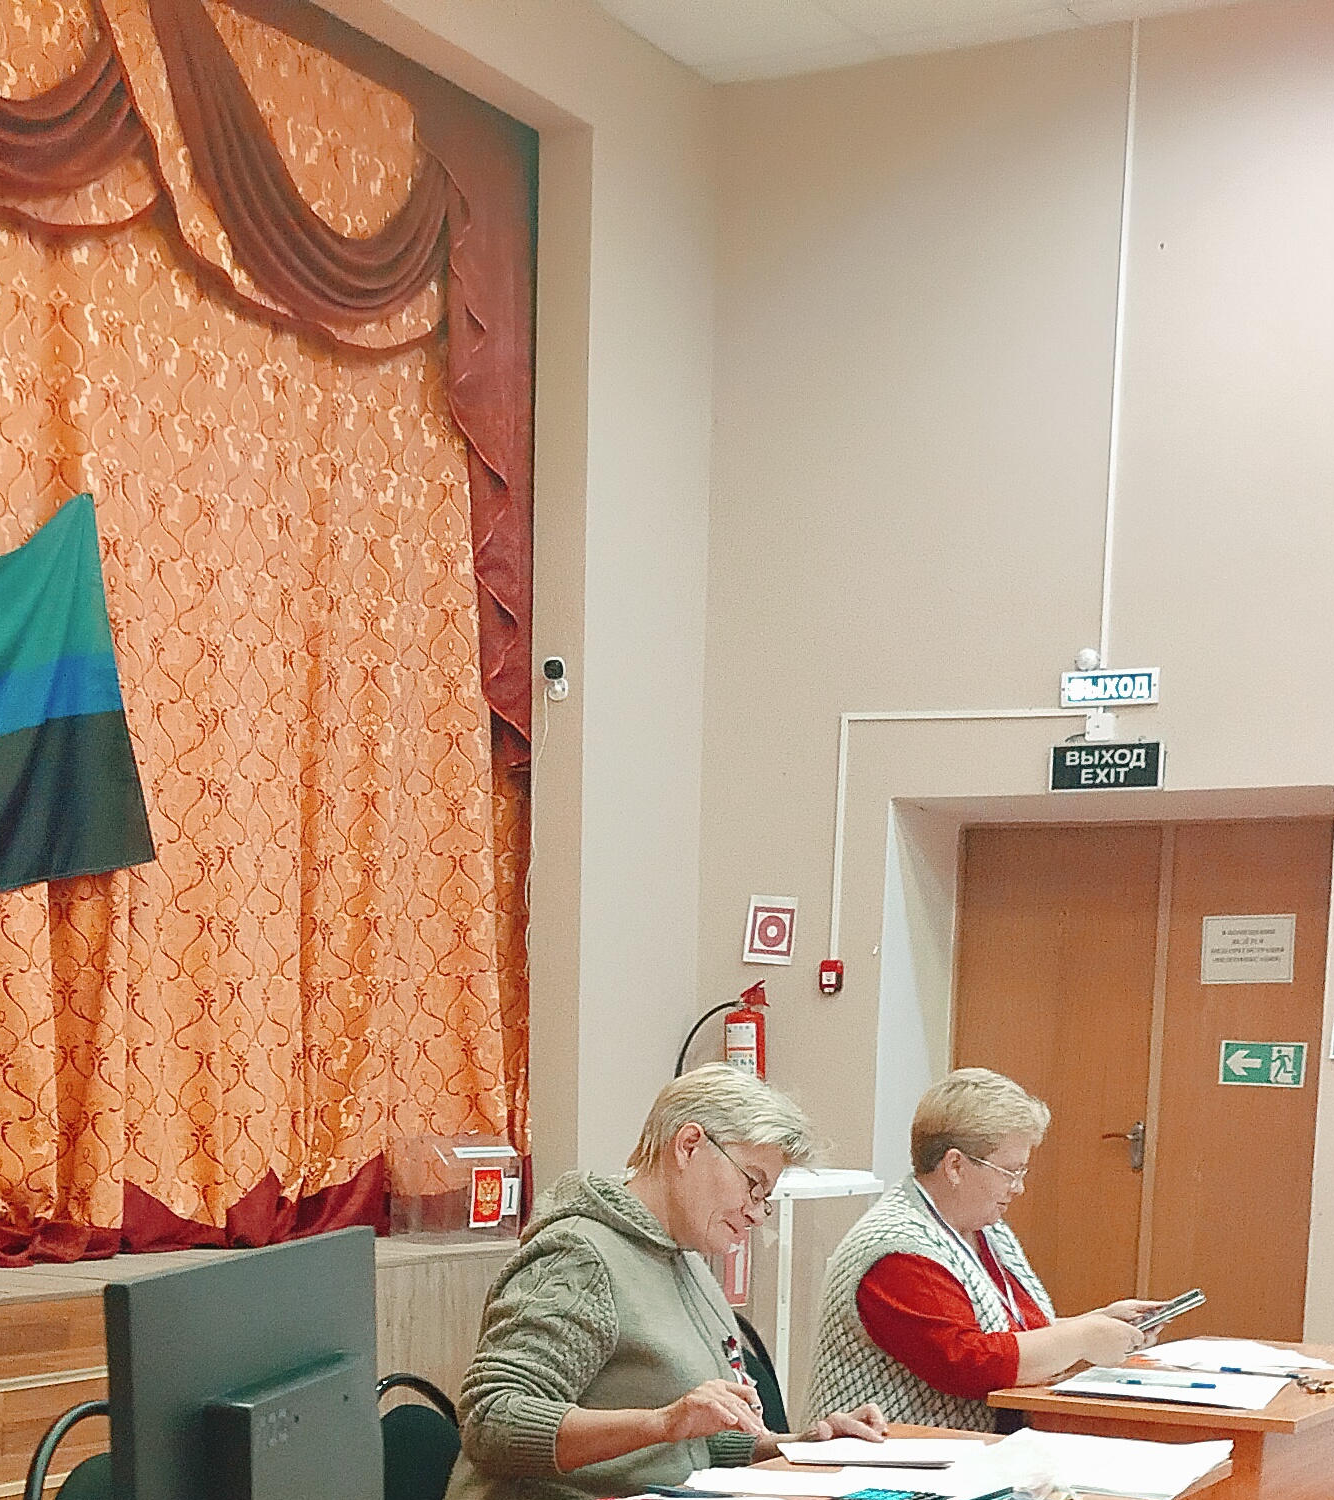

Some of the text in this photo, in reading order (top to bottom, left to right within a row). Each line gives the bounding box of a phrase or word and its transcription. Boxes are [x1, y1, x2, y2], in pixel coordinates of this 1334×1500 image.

[1065, 748, 1146, 769] ВЫХОД
[1080, 767, 1129, 784] EXIT
[506, 1183, 514, 1209] 1
